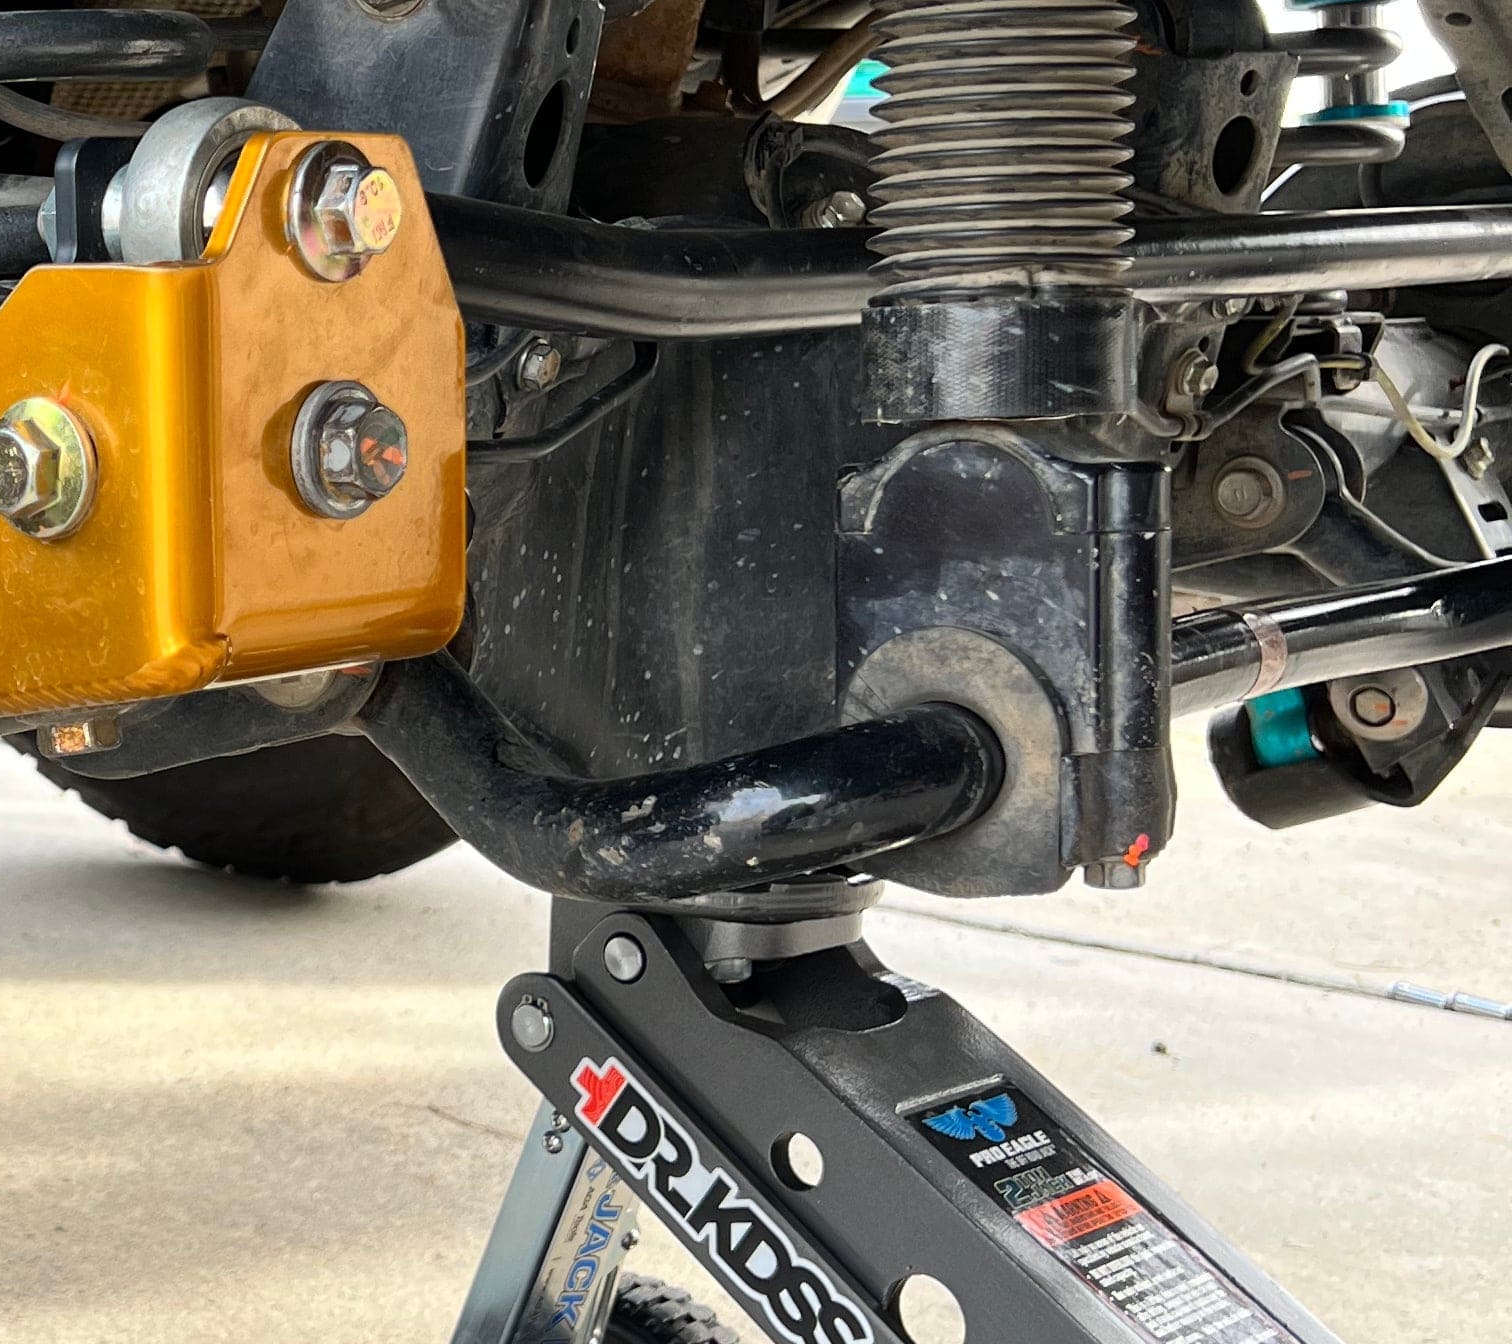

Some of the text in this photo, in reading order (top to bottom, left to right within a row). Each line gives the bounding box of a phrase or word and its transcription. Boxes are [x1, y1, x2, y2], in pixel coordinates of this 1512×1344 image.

[968, 1147, 1004, 1169] PRO
[1002, 1129, 1052, 1157] EAGLE
[545, 1190, 623, 1333] JACK
